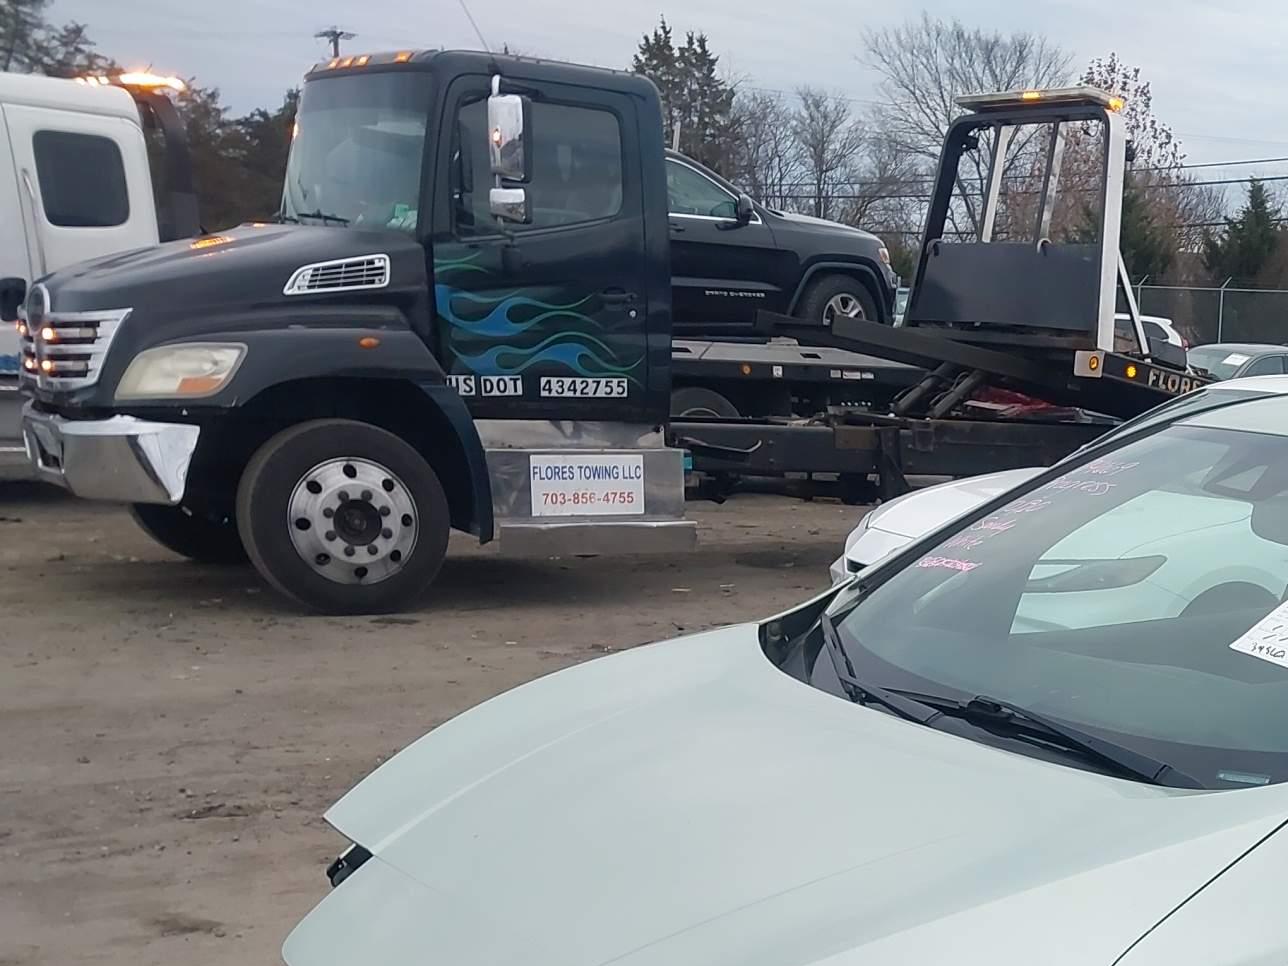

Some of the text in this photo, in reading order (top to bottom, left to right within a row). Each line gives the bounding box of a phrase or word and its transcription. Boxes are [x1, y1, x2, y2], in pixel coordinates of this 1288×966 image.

[482, 377, 522, 394] DOT
[541, 379, 627, 396] 4342755
[532, 464, 642, 481] FLORES TOWING LLC
[542, 492, 635, 506] 703-856-4755
